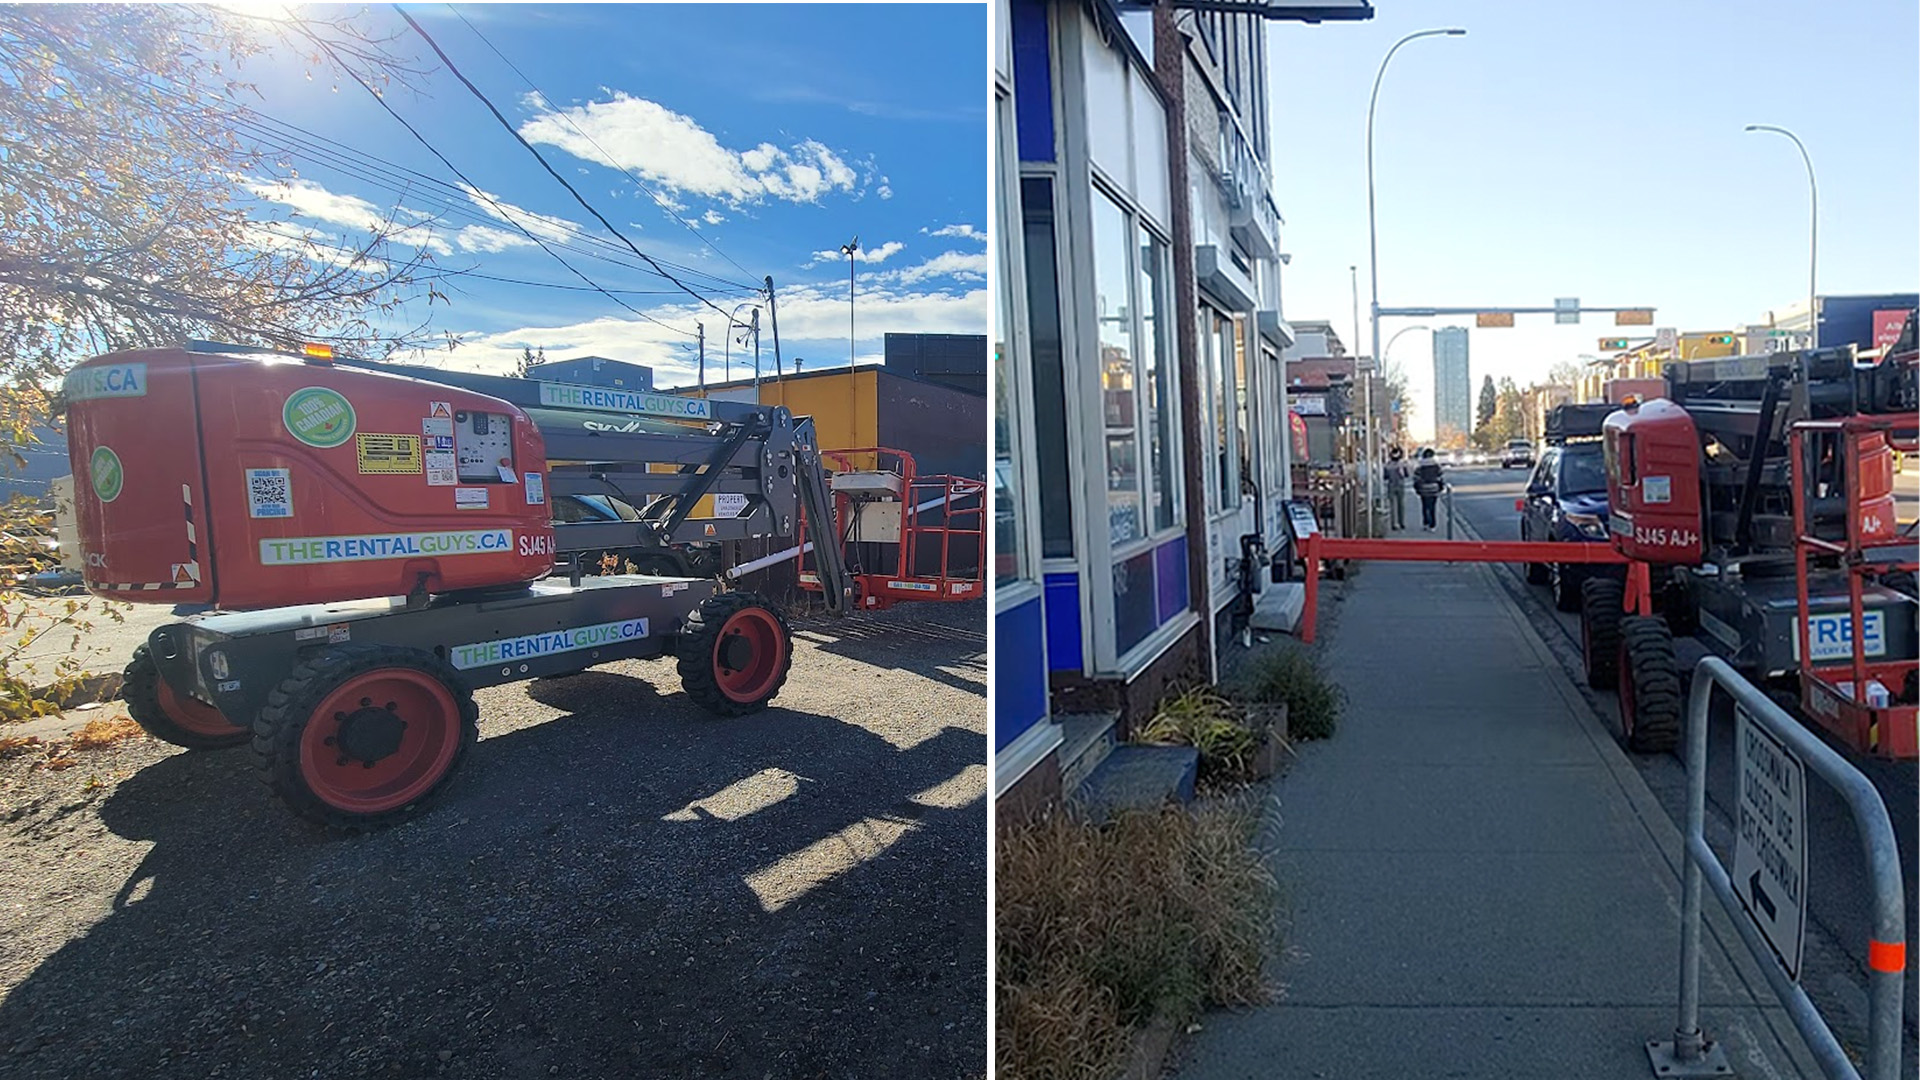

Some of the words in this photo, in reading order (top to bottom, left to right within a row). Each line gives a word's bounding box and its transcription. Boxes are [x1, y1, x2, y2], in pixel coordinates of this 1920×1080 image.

[297, 396, 326, 415] 100%
[546, 386, 706, 416] THERENTALGUYS.CA
[295, 401, 345, 432] CANADIAN
[269, 532, 508, 561] THERENTALGUYS.CA
[519, 535, 546, 556] SJ45
[1635, 526, 1667, 545] SJ45
[1670, 529, 1698, 547] AJ+
[458, 621, 645, 665] THERENTALGUYS.CA
[1808, 615, 1880, 643] REE
[1744, 768, 1773, 826] CLOSED
